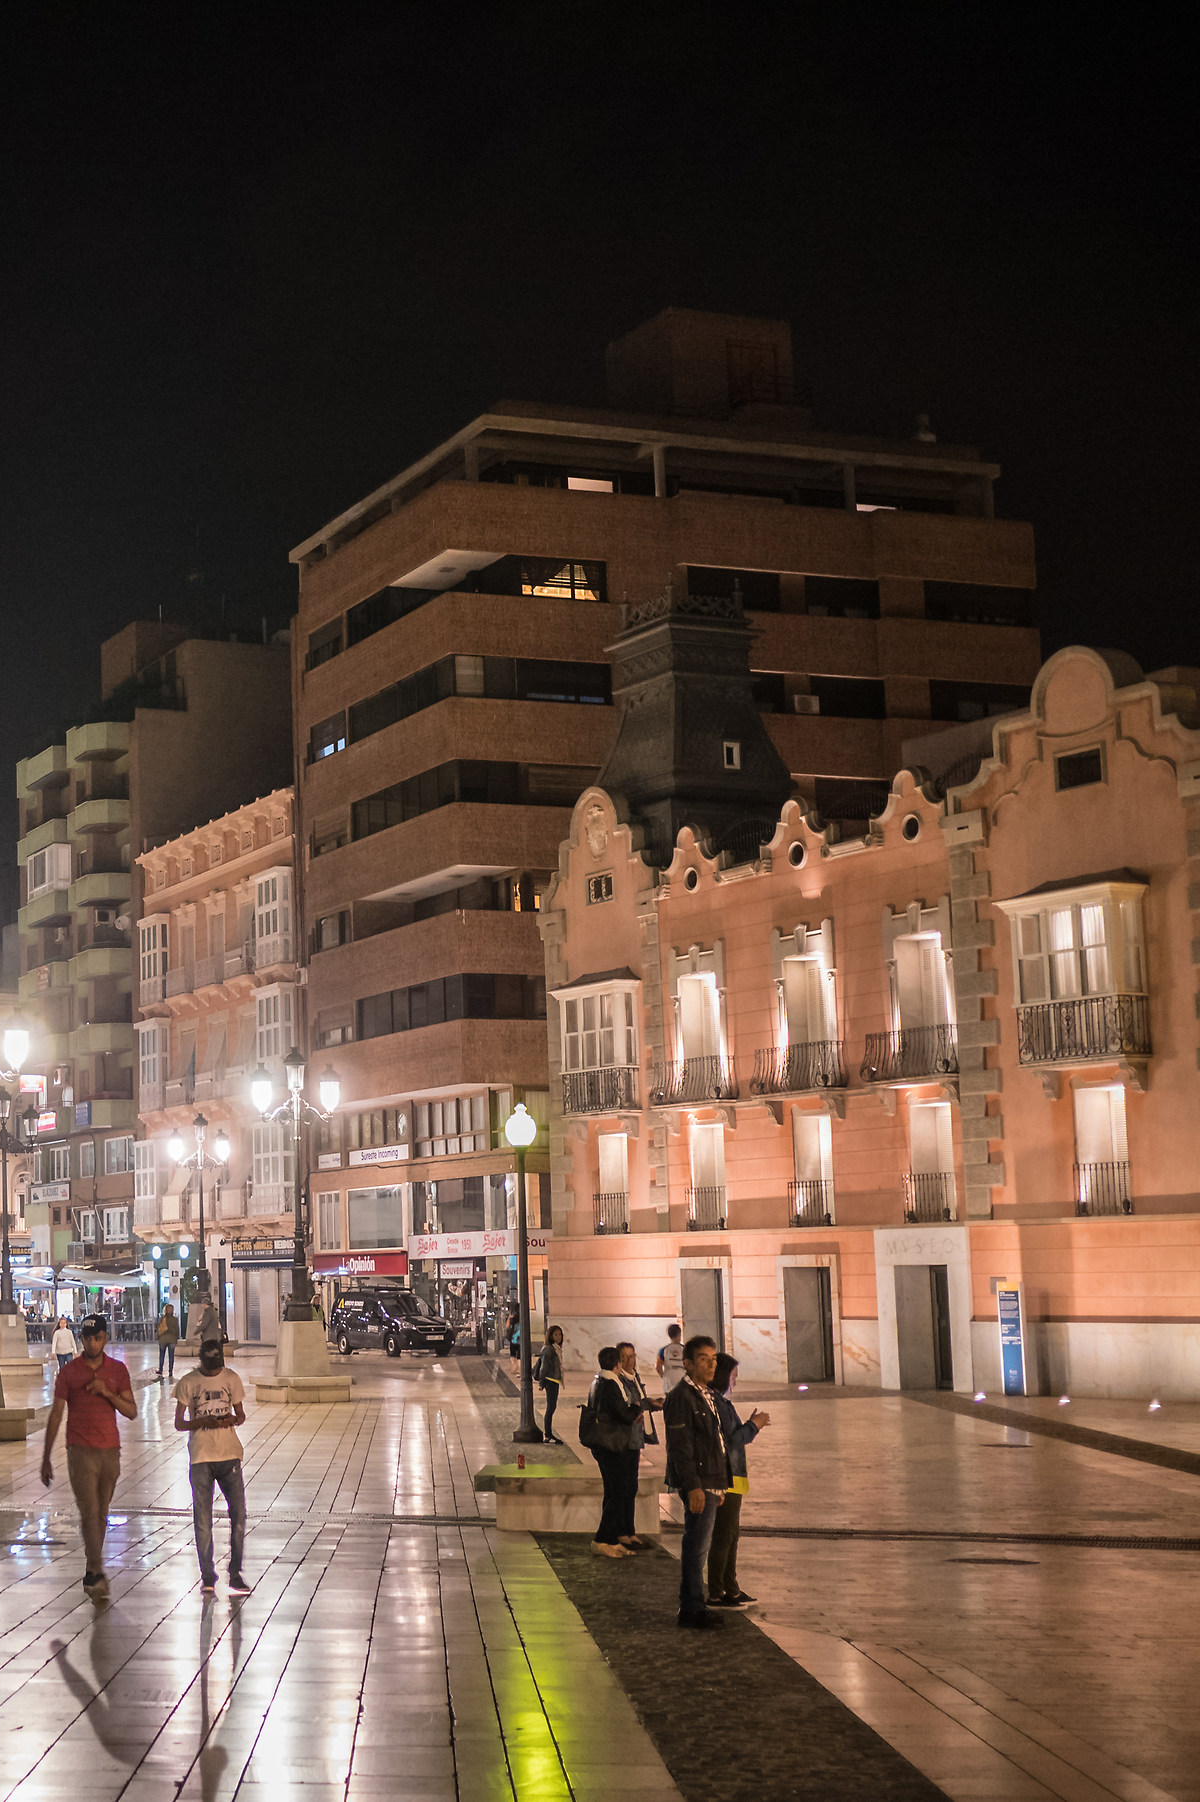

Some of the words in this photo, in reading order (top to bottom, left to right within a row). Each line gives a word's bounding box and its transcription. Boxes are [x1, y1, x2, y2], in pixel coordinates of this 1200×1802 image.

[361, 1150, 377, 1161] Sureste
[377, 1148, 399, 1159] Incoming
[442, 1264, 471, 1275] Souvenirs
